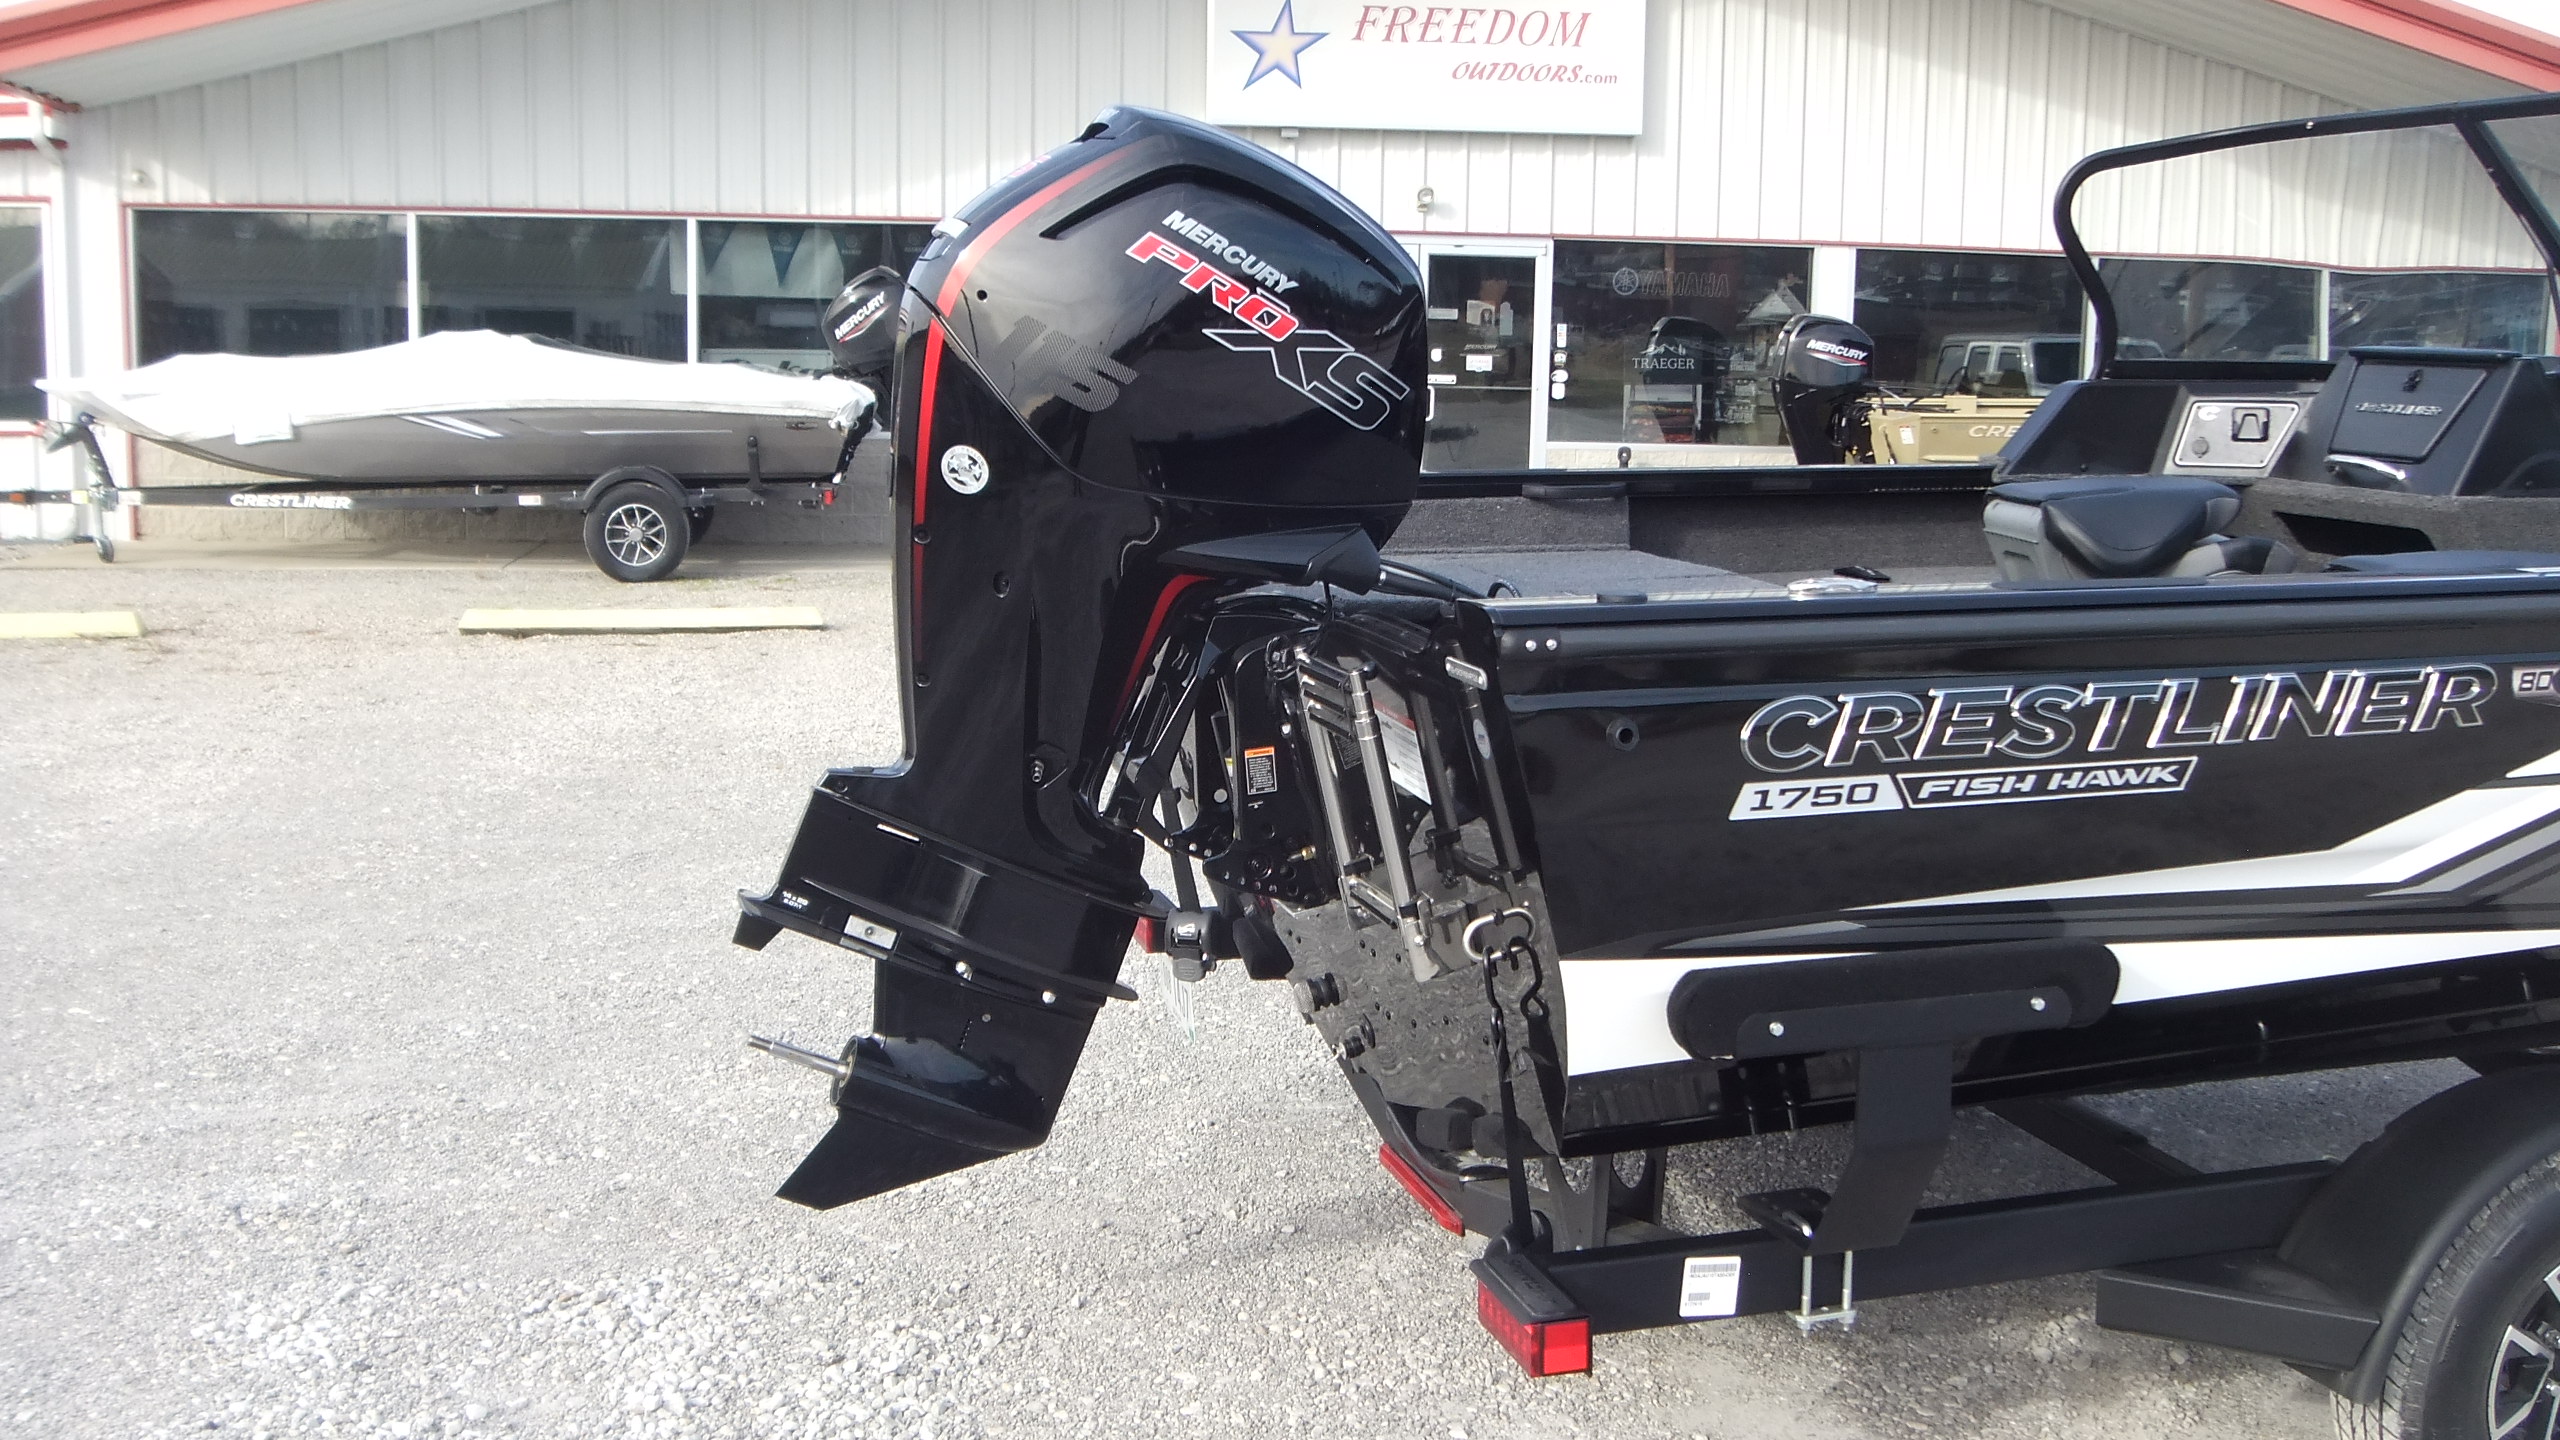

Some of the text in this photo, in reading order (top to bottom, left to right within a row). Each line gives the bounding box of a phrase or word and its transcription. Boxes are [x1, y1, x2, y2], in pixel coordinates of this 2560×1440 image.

[1351, 5, 1592, 48] FREEDOM
[1161, 209, 1300, 295] MERCURY
[1125, 231, 1300, 342] PRO
[834, 291, 885, 340] MERCURY
[1632, 358, 1695, 369] TRAEGER
[1806, 339, 1869, 361] MERCURY
[1201, 329, 1410, 430] XS
[230, 493, 351, 509] CRESTLINER
[1740, 664, 2498, 774] CRESTLINER
[1750, 764, 2180, 812] 1750 FISH HAWK
